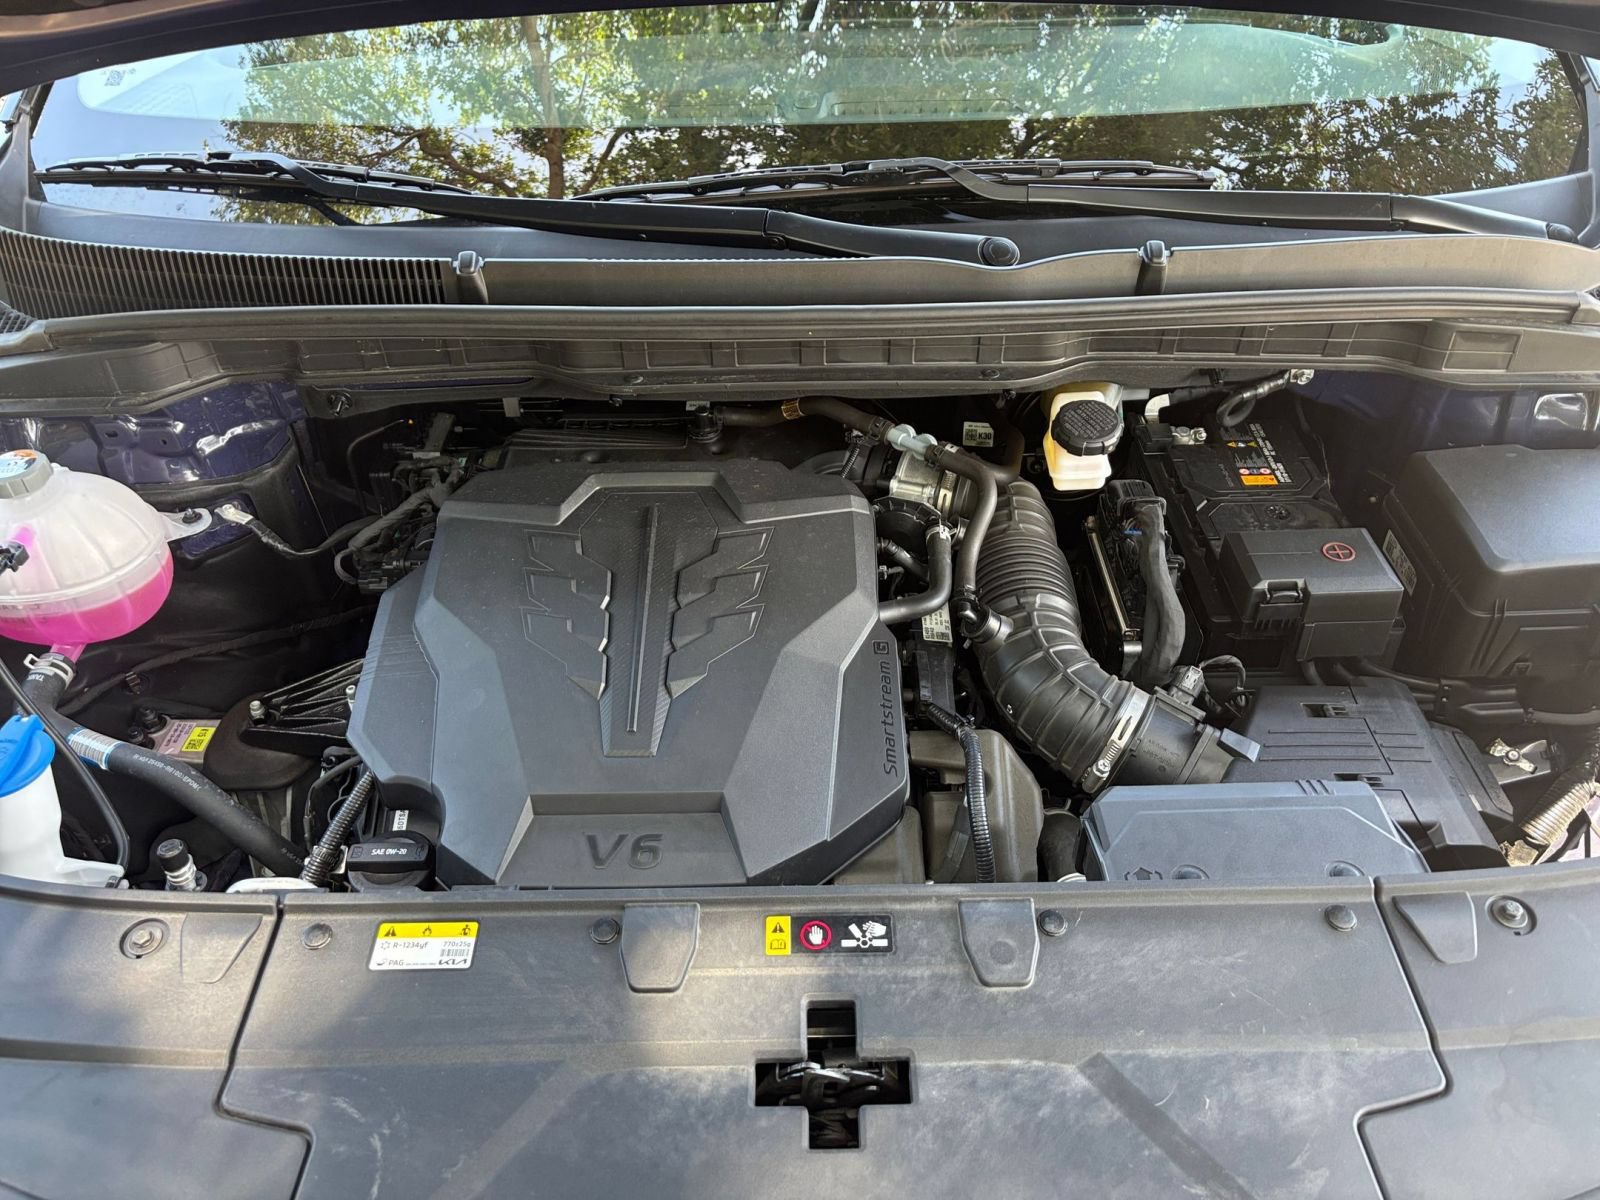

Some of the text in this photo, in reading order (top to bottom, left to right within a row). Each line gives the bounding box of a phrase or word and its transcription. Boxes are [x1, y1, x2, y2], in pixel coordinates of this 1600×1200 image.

[880, 661, 898, 777] Smartstream
[371, 848, 386, 856] SAE
[582, 832, 664, 870] V6
[392, 941, 428, 950] R-1234yf
